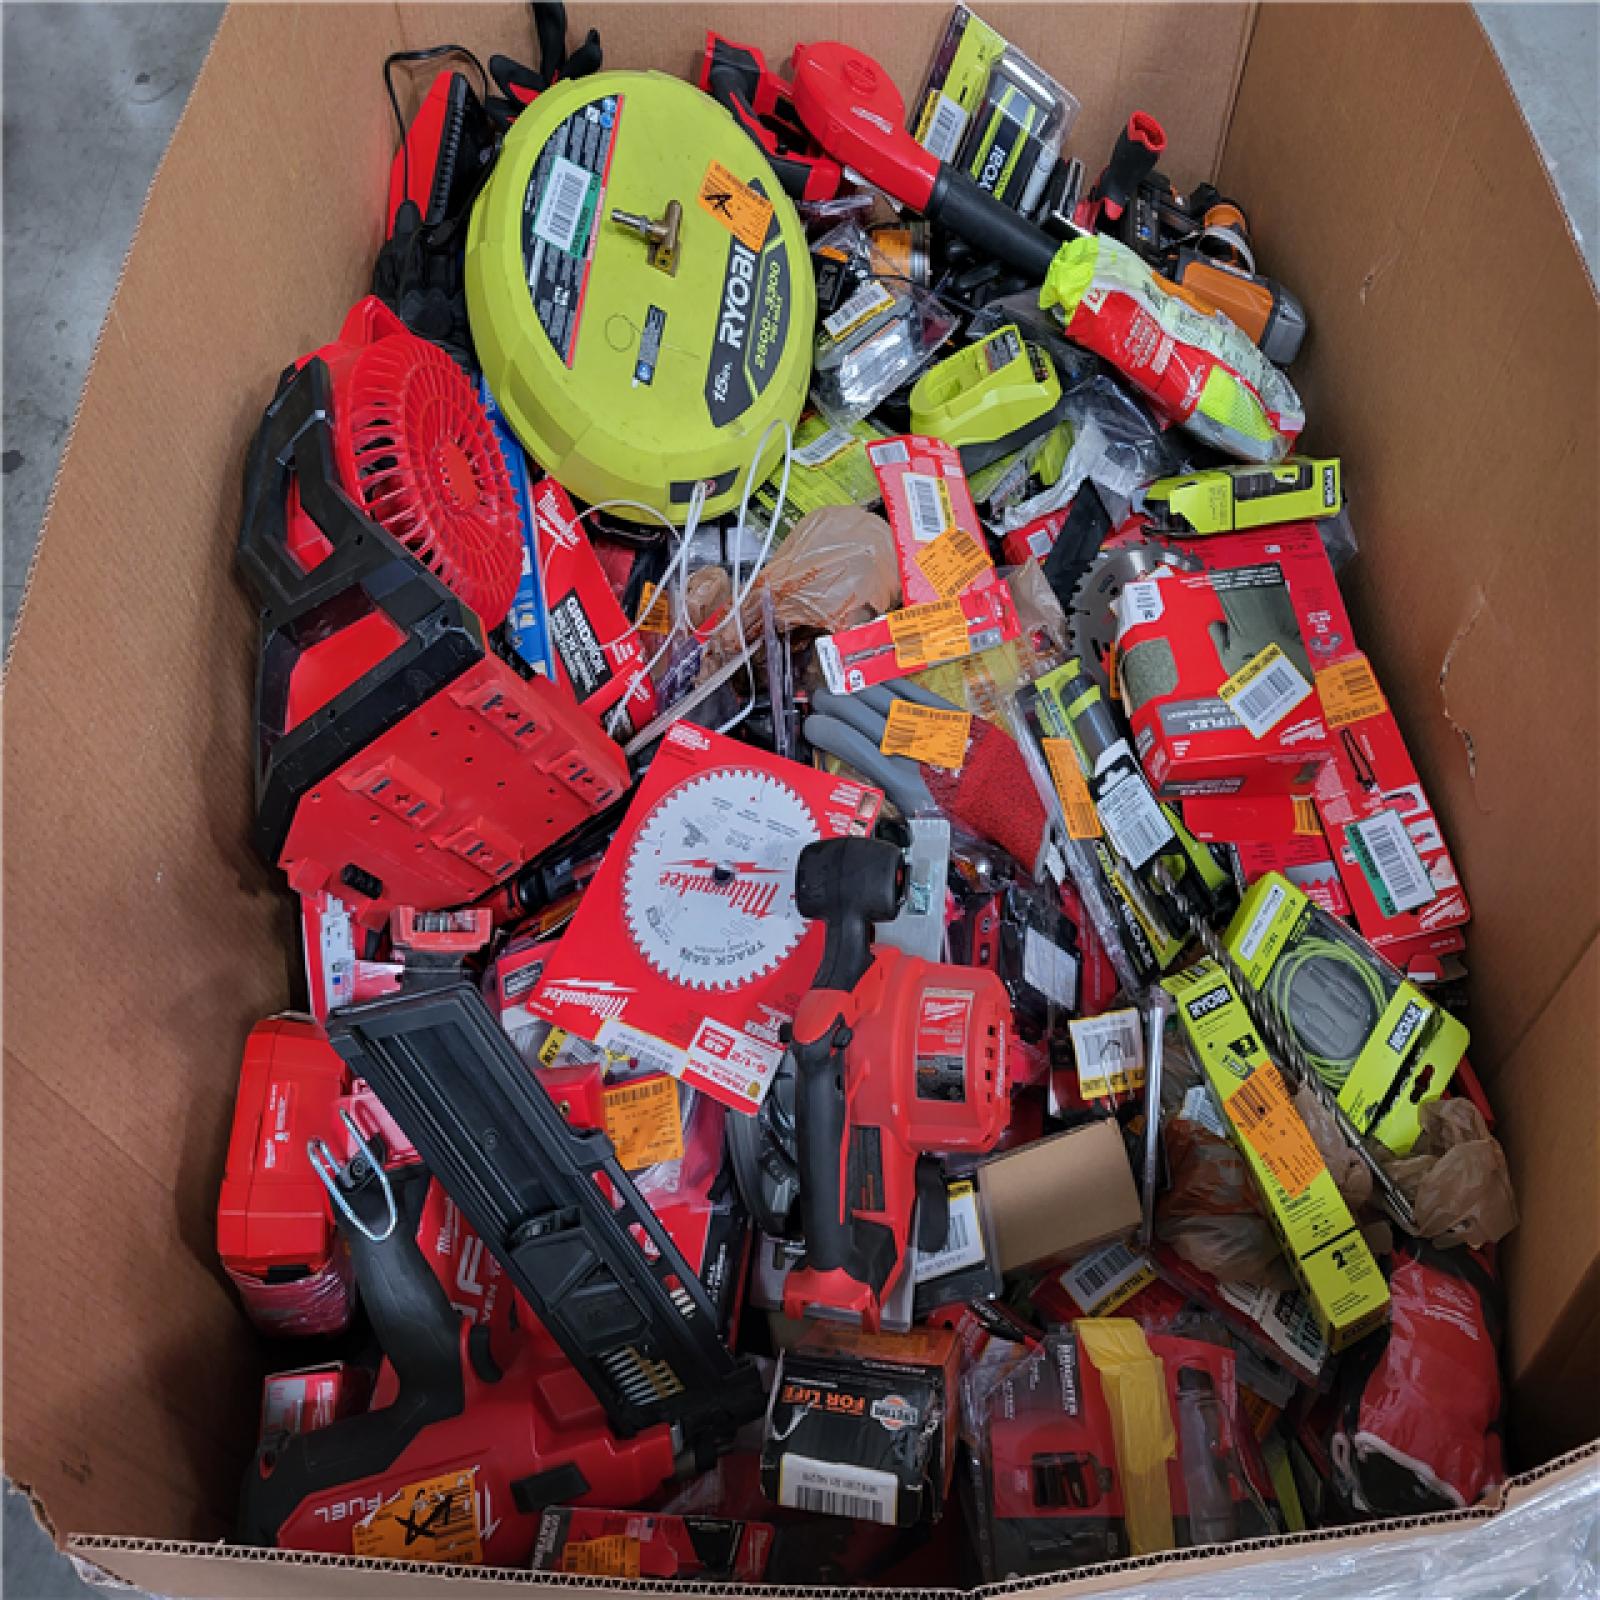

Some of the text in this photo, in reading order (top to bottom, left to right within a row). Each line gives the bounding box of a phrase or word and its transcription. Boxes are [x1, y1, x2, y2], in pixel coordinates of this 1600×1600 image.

[979, 145, 1006, 191] YOBI
[718, 243, 757, 349] RYOBI
[659, 870, 780, 919] Milwaukee
[715, 940, 766, 966] TRACK
[542, 986, 629, 1020] Milwaukee
[1188, 986, 1231, 1019] RYOBI
[1389, 1001, 1429, 1050] RYOBI
[1330, 1248, 1348, 1270] 2
[825, 1393, 865, 1413] FOR
[314, 1493, 384, 1524] FUEL
